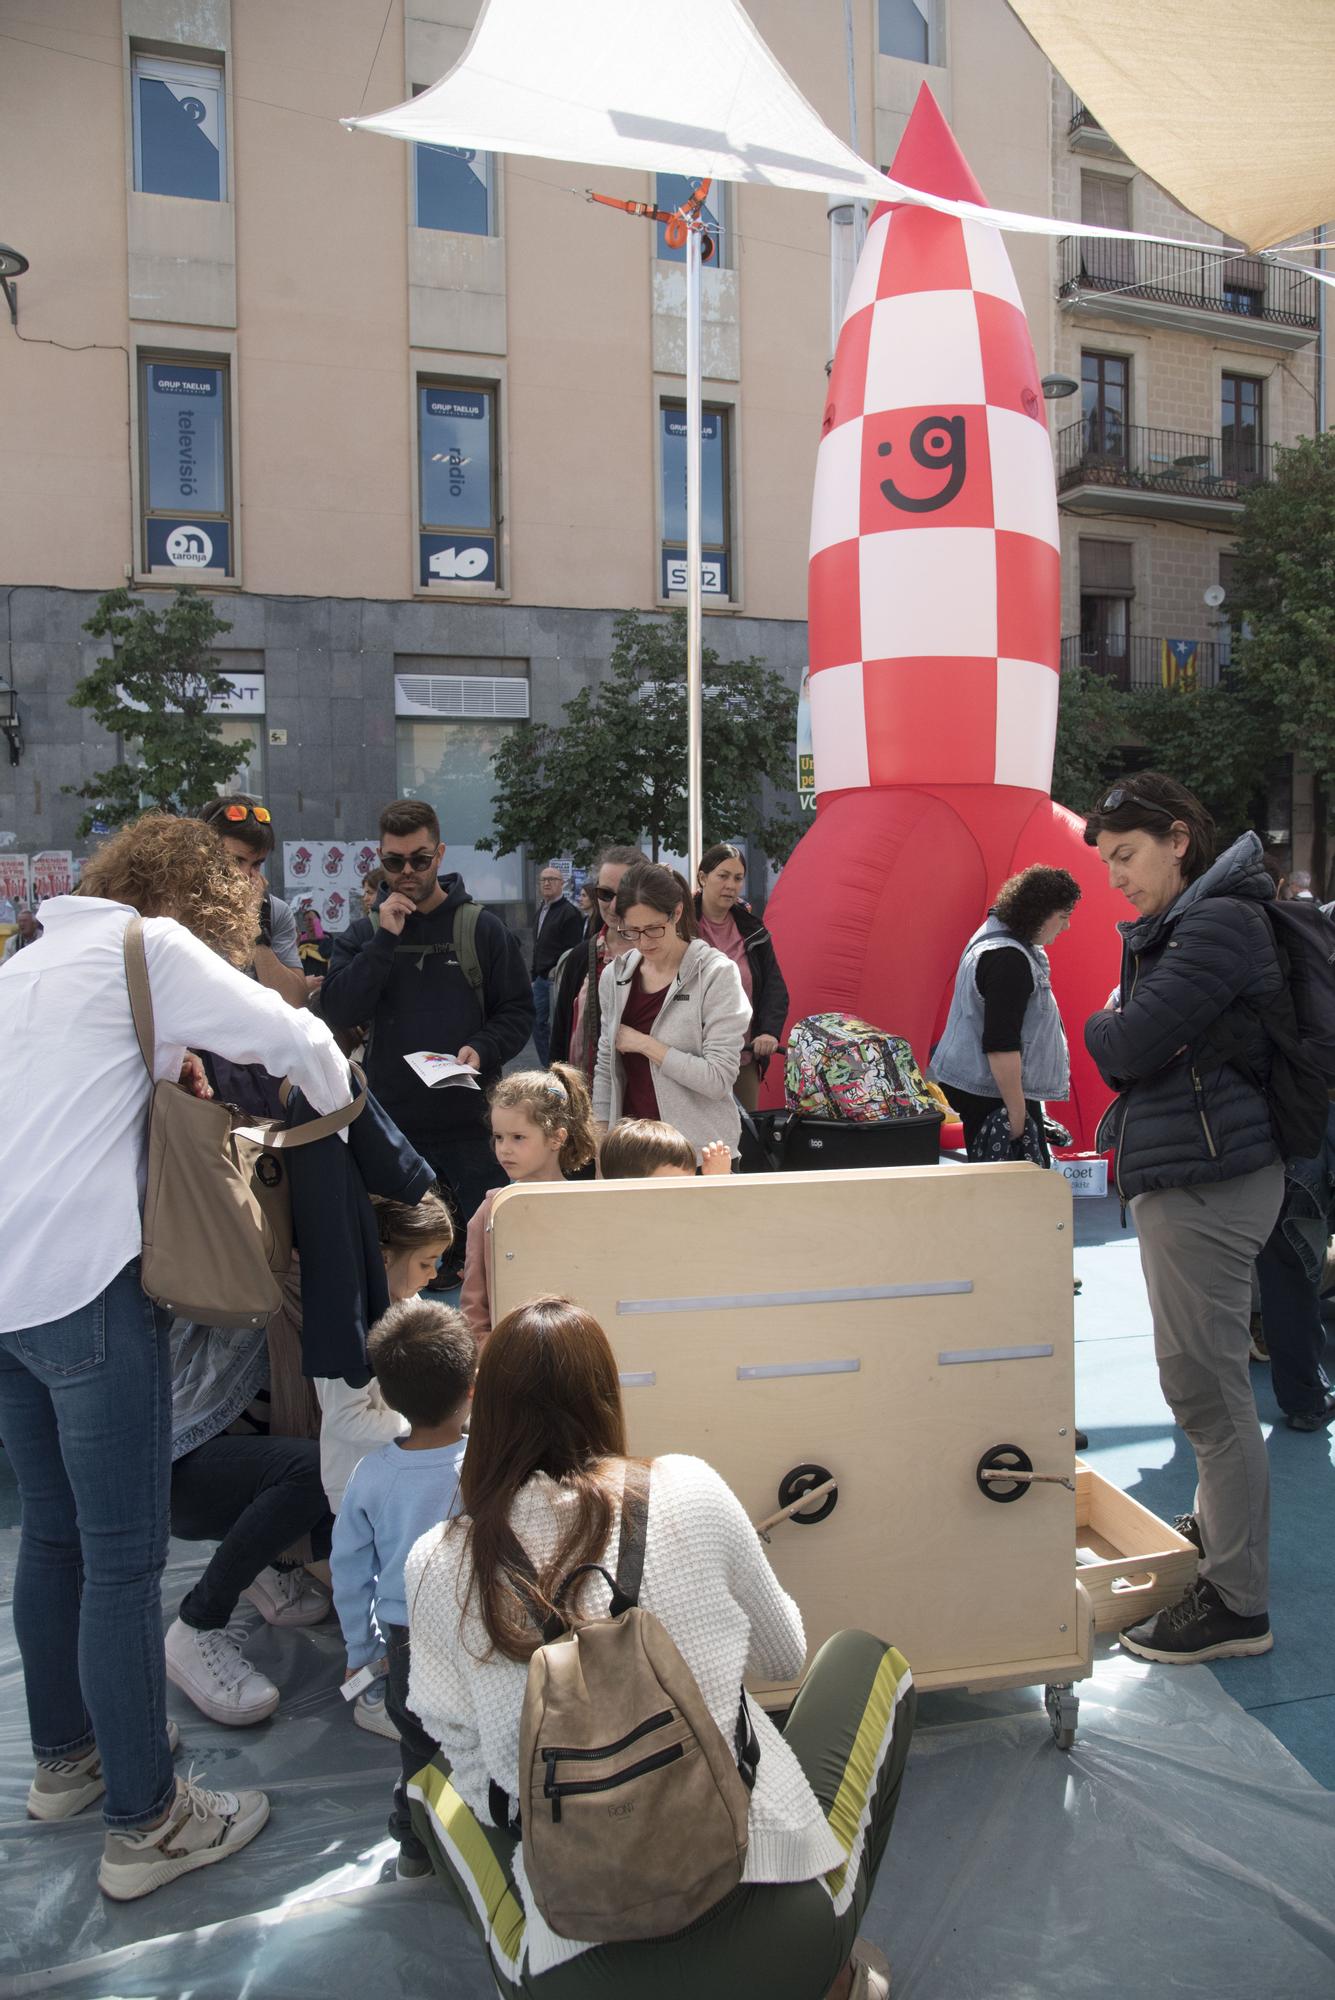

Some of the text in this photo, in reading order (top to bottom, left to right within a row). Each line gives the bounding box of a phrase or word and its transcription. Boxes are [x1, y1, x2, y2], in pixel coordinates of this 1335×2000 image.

[158, 380, 181, 389] GRUP
[182, 382, 211, 391] TAELUS
[431, 403, 452, 411] GRUP
[453, 405, 479, 414] TAELUS
[178, 410, 197, 496] televisió
[172, 553, 207, 562] taronja
[671, 568, 717, 587] SR
[1063, 1166, 1093, 1179] Coet
